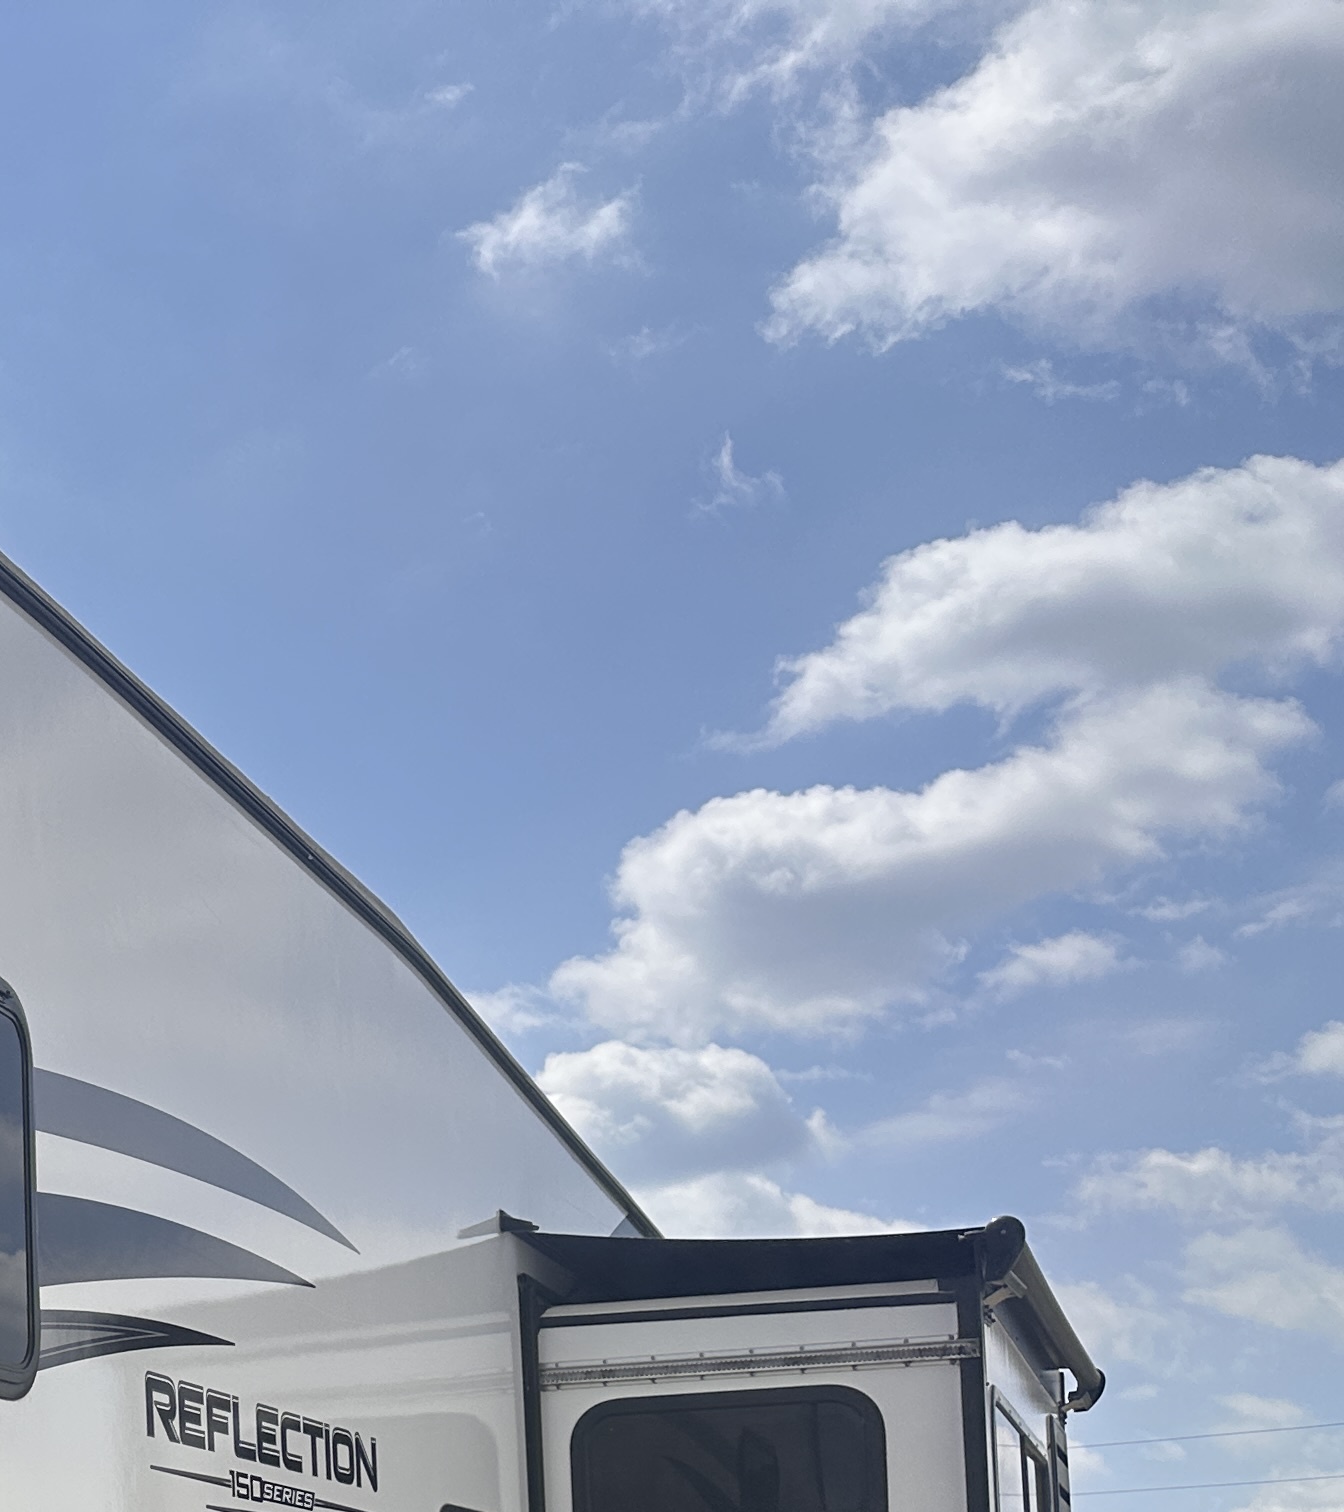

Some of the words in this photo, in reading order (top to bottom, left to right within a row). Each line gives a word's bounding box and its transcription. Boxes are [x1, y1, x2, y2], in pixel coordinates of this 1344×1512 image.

[145, 1370, 378, 1493] REFLECTION
[229, 1469, 263, 1503] 150
[262, 1481, 315, 1511] SERIES
